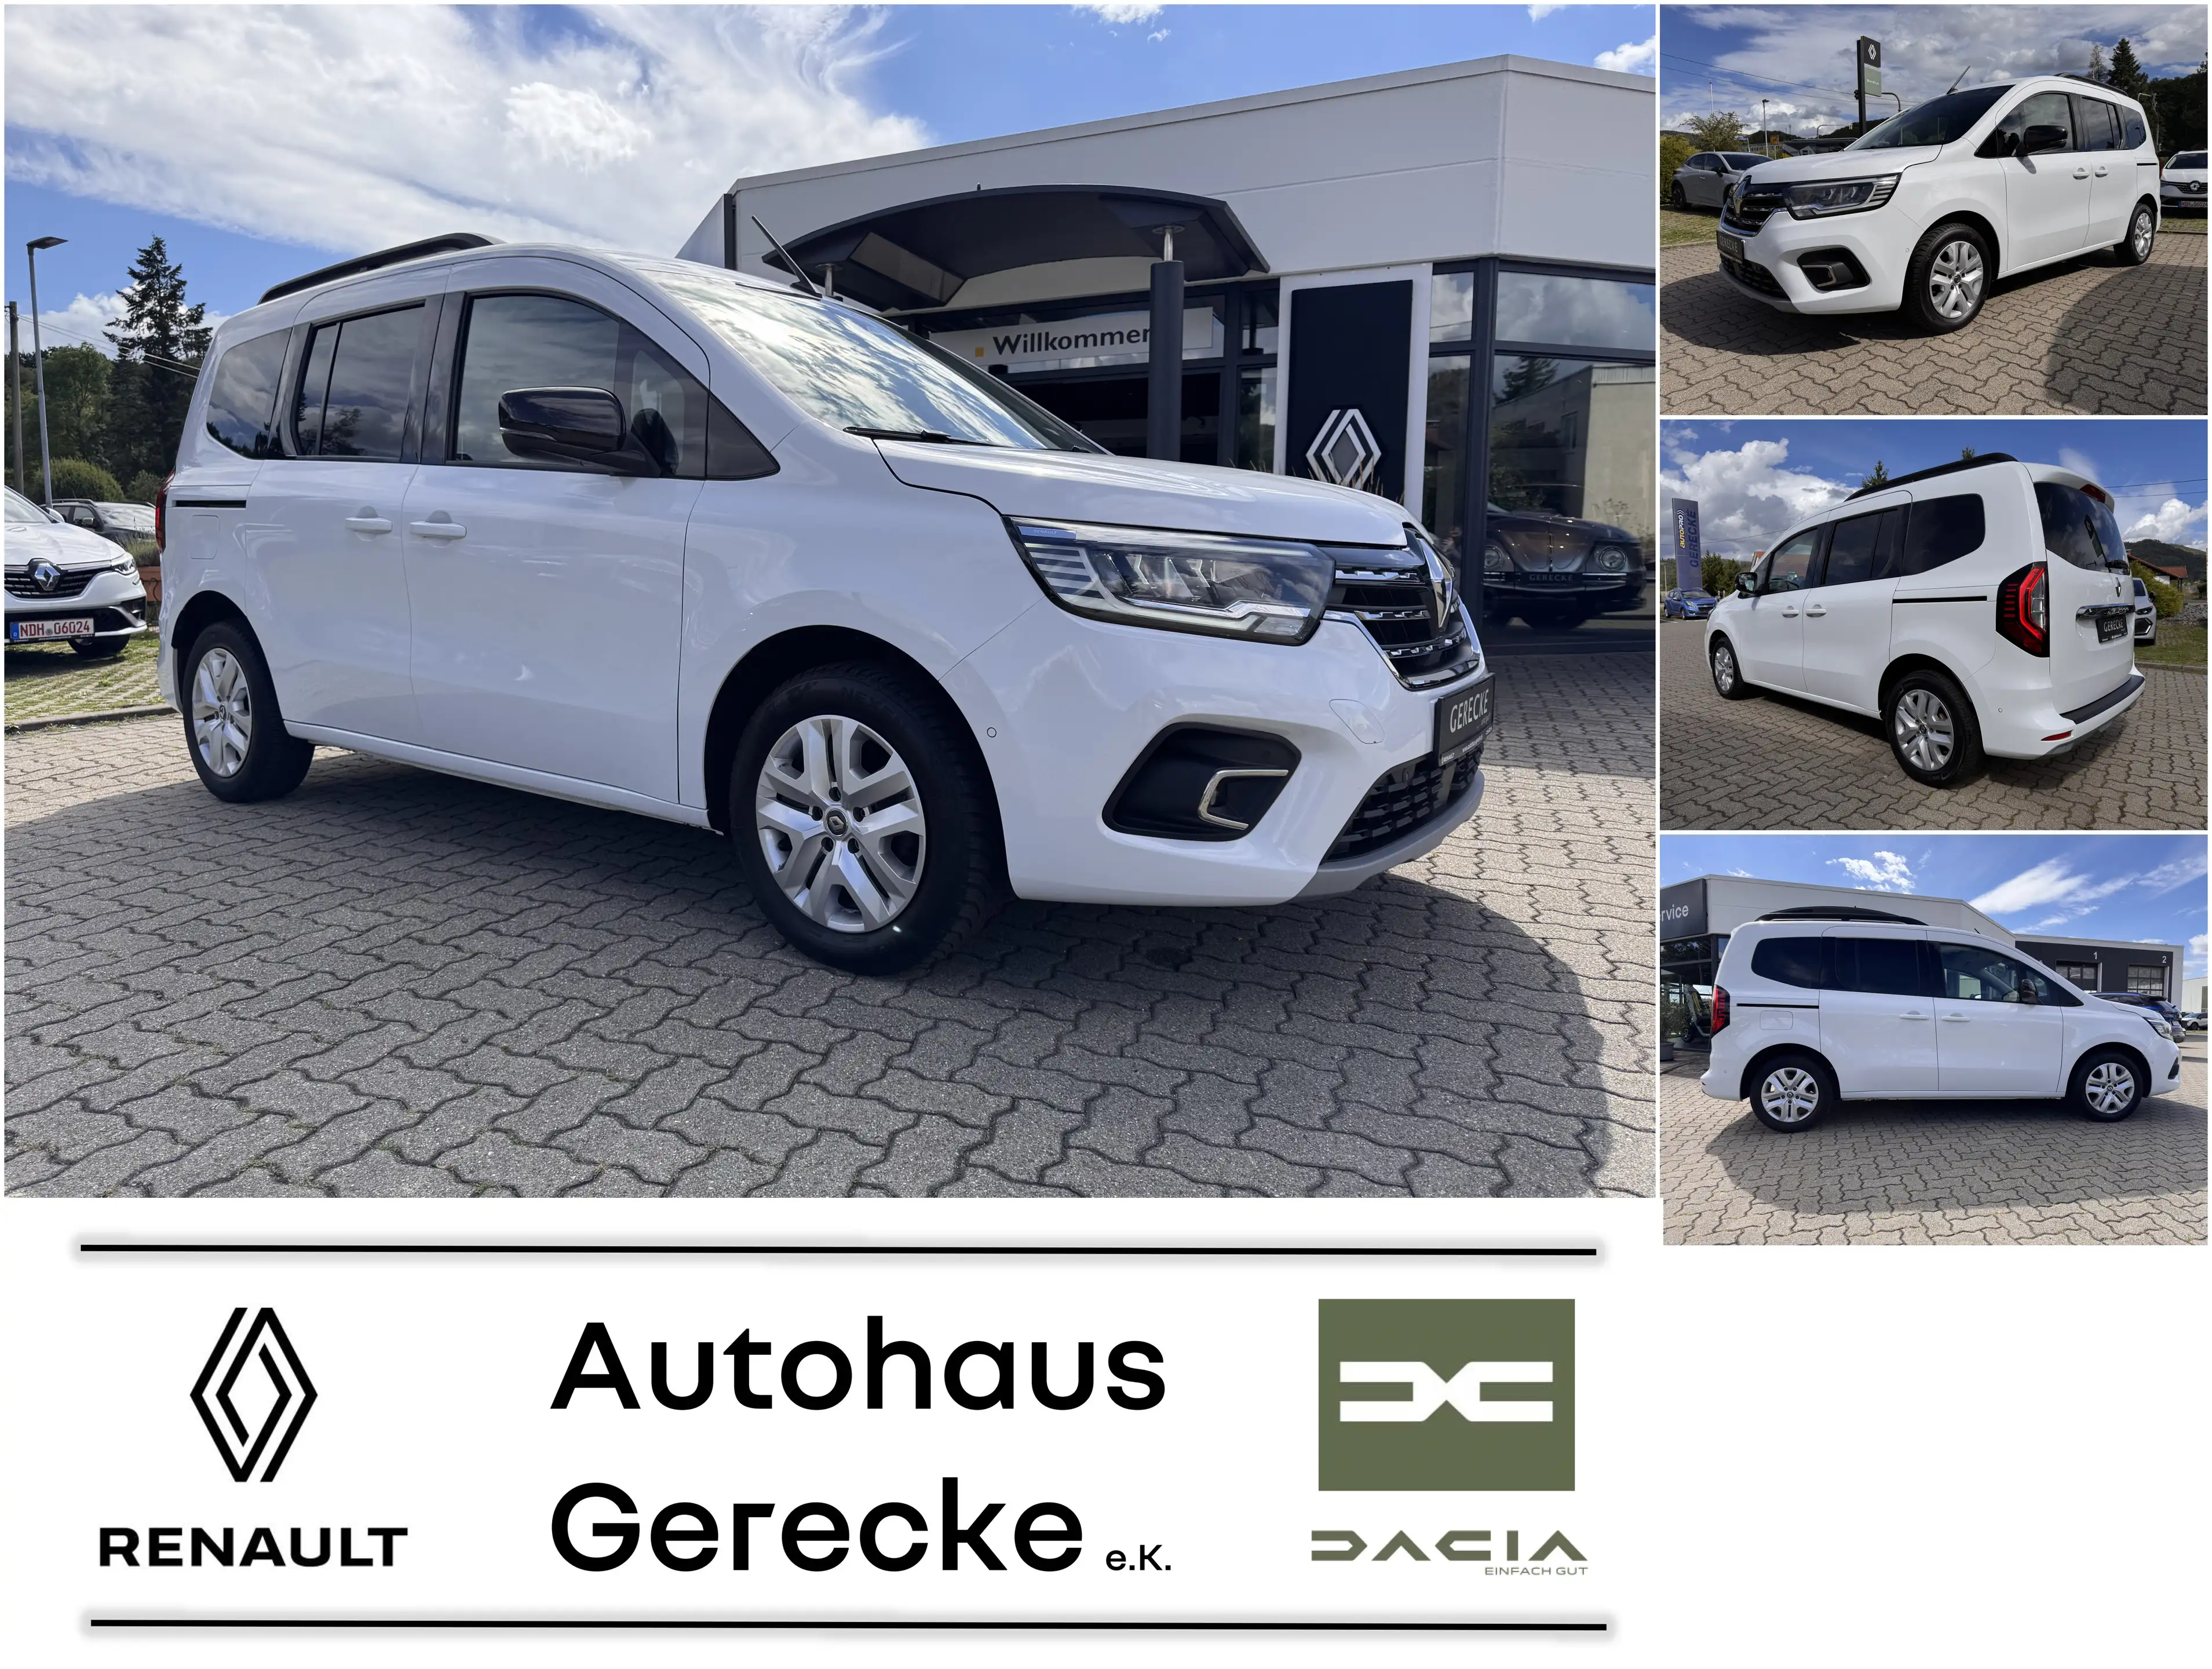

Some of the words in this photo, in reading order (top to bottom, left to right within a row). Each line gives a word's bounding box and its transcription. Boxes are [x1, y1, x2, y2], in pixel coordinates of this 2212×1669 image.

[1687, 509, 1699, 567] GERECKE
[20, 623, 45, 637] NDH
[2104, 619, 2123, 632] GERECKE
[1450, 688, 1489, 733] GERECKE
[1660, 904, 1689, 921] rvice
[2093, 952, 2097, 960] 1
